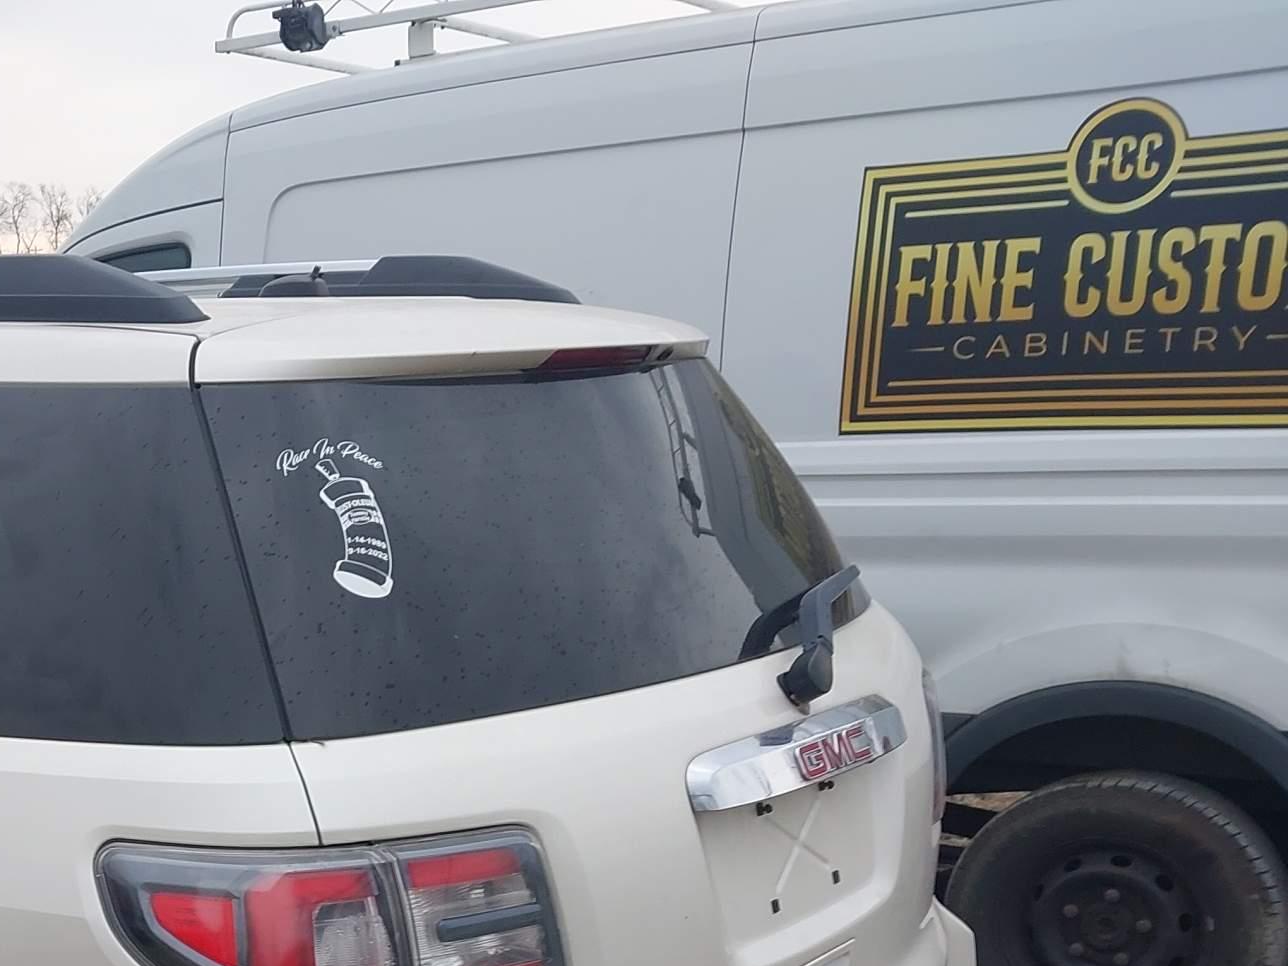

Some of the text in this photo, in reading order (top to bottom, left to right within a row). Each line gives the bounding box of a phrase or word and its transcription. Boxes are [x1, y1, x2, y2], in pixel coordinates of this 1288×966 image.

[1087, 133, 1163, 185] FCC
[891, 220, 1288, 329] FINE CUSTO
[953, 325, 1258, 360] CABINETRY
[276, 438, 384, 477] Race In Peace
[796, 724, 875, 781] GMC
